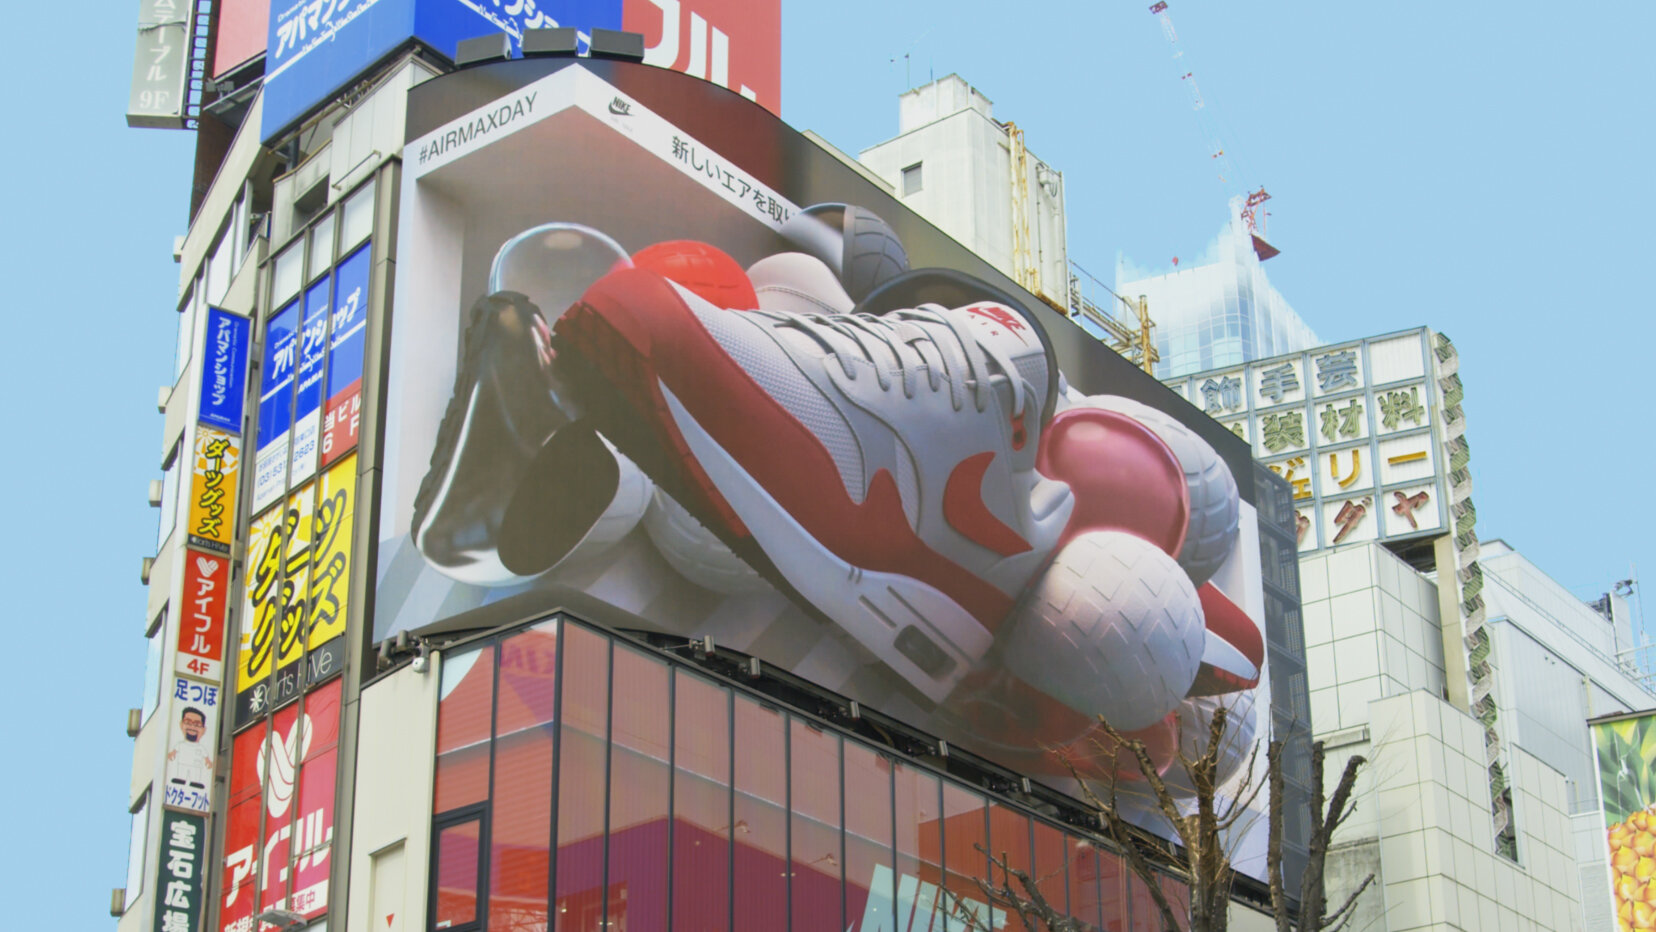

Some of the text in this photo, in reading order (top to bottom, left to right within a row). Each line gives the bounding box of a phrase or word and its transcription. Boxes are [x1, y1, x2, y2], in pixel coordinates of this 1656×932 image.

[140, 90, 170, 110] 9F
[418, 91, 537, 166] #AIRMAXDAY
[613, 96, 631, 113] NIKE
[324, 394, 361, 432] 当ビル
[1170, 350, 1358, 414] 飾手芸
[1231, 387, 1425, 452] 装材料
[197, 439, 231, 538] ダーツグッズ
[252, 488, 347, 607] ダーツ
[191, 578, 215, 654] アイフル
[174, 678, 218, 706] 足つぼ
[186, 659, 210, 675] 4F
[162, 820, 197, 932] 宝石広場
